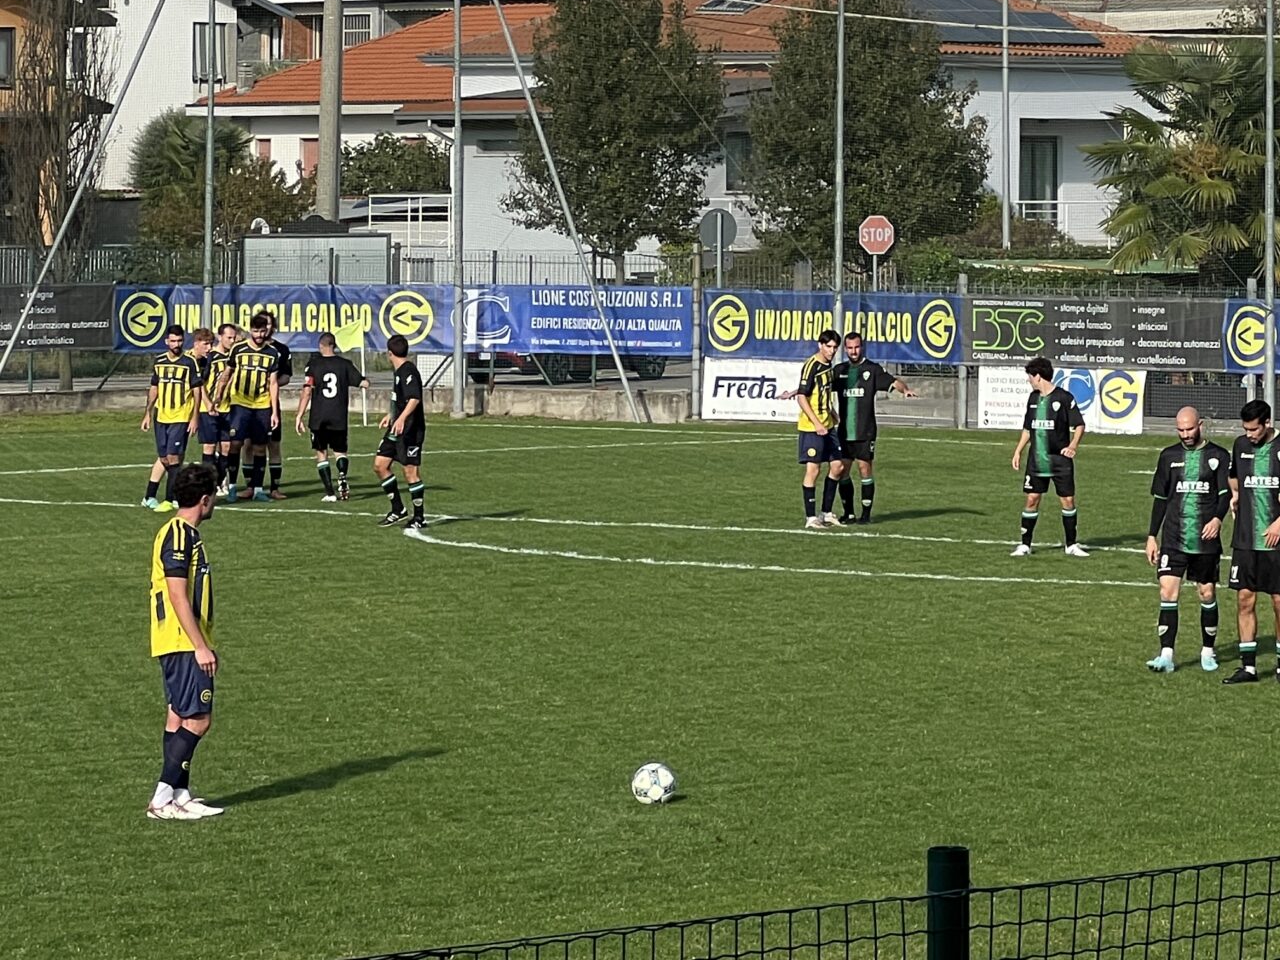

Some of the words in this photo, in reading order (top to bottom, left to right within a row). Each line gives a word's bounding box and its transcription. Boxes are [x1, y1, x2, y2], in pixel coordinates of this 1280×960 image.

[862, 227, 892, 242] STOP
[531, 289, 566, 307] LIONE
[569, 289, 647, 308] COSTRUZIONI
[650, 291, 684, 309] S.R.L
[1060, 303, 1085, 315] stampe
[1086, 302, 1109, 316] digitali
[1137, 304, 1166, 317] insegne
[175, 303, 236, 333] UNON
[531, 317, 561, 330] EDIFICI
[562, 317, 613, 330] RESIDENZIAI
[615, 319, 625, 331] DI
[627, 319, 647, 331] ALTA
[648, 317, 682, 332] QUALITÀ
[755, 308, 801, 341] UNION
[804, 310, 854, 342] GORA
[1060, 319, 1085, 331] grande
[1137, 321, 1168, 331] striscioni
[1060, 335, 1085, 346] adesivi
[1085, 338, 1125, 349] prespaziati
[1137, 336, 1182, 348] decorazione
[1183, 339, 1220, 349] automezzi
[1089, 353, 1095, 362] in
[1096, 354, 1125, 364] cartone
[1136, 353, 1186, 365] cartellonistica
[322, 372, 338, 399] 3
[712, 375, 777, 400] Freda
[1009, 377, 1030, 385] RESIDE
[1176, 481, 1210, 491] ARTES
[1244, 476, 1279, 486] ARTES
[1160, 554, 1169, 568] 9
